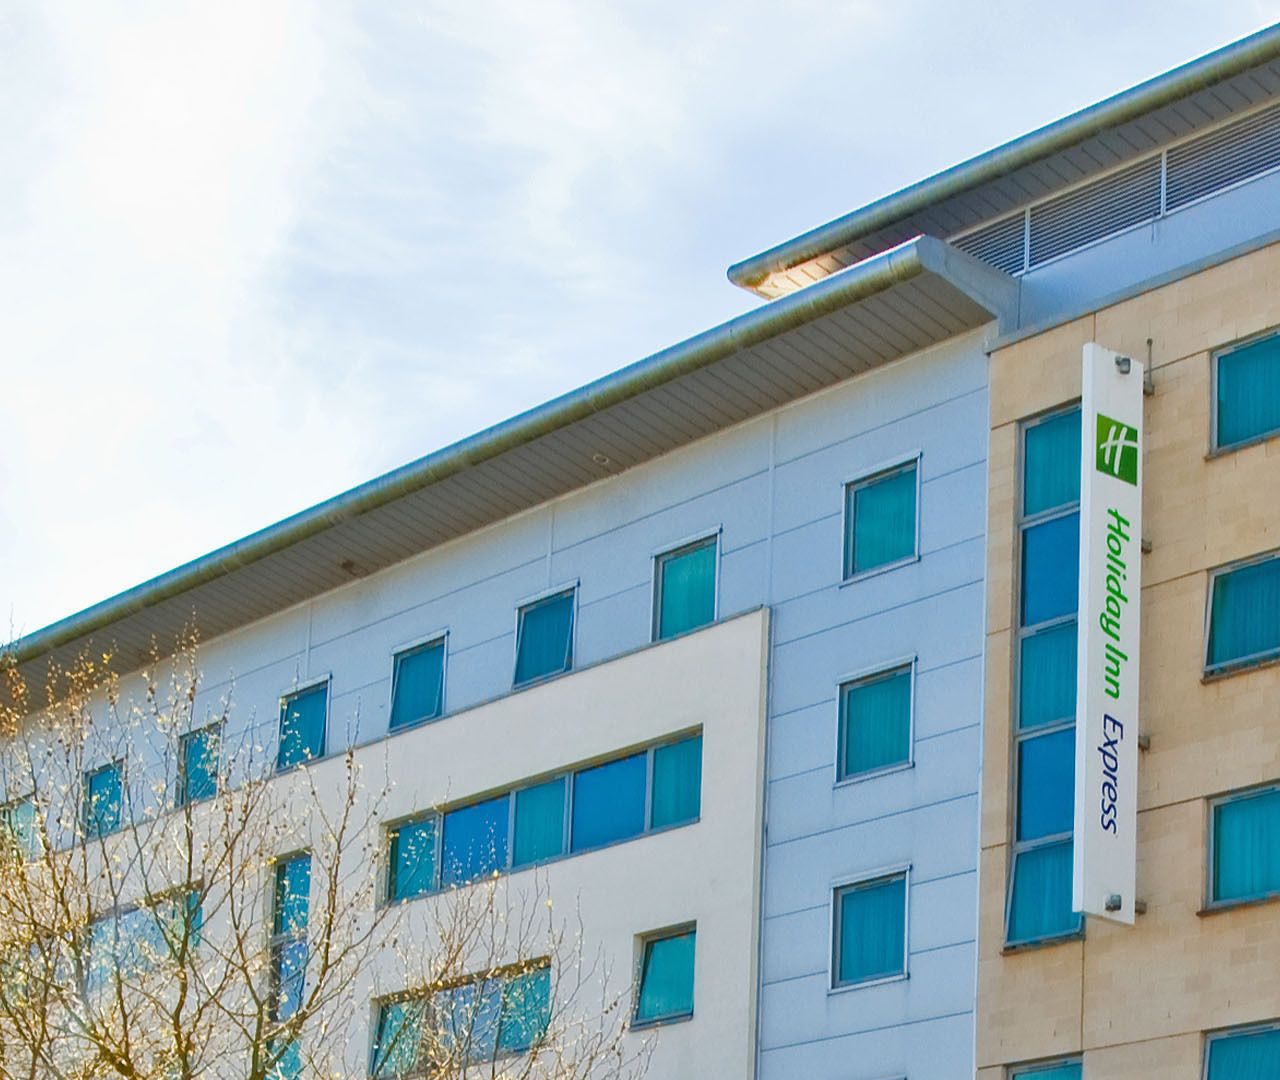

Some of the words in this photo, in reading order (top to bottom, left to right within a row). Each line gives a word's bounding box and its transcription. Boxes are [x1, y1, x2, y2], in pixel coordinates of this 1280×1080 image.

[1100, 508, 1130, 641] Holiday
[1105, 643, 1129, 699] Inn
[1097, 713, 1124, 834] Express
